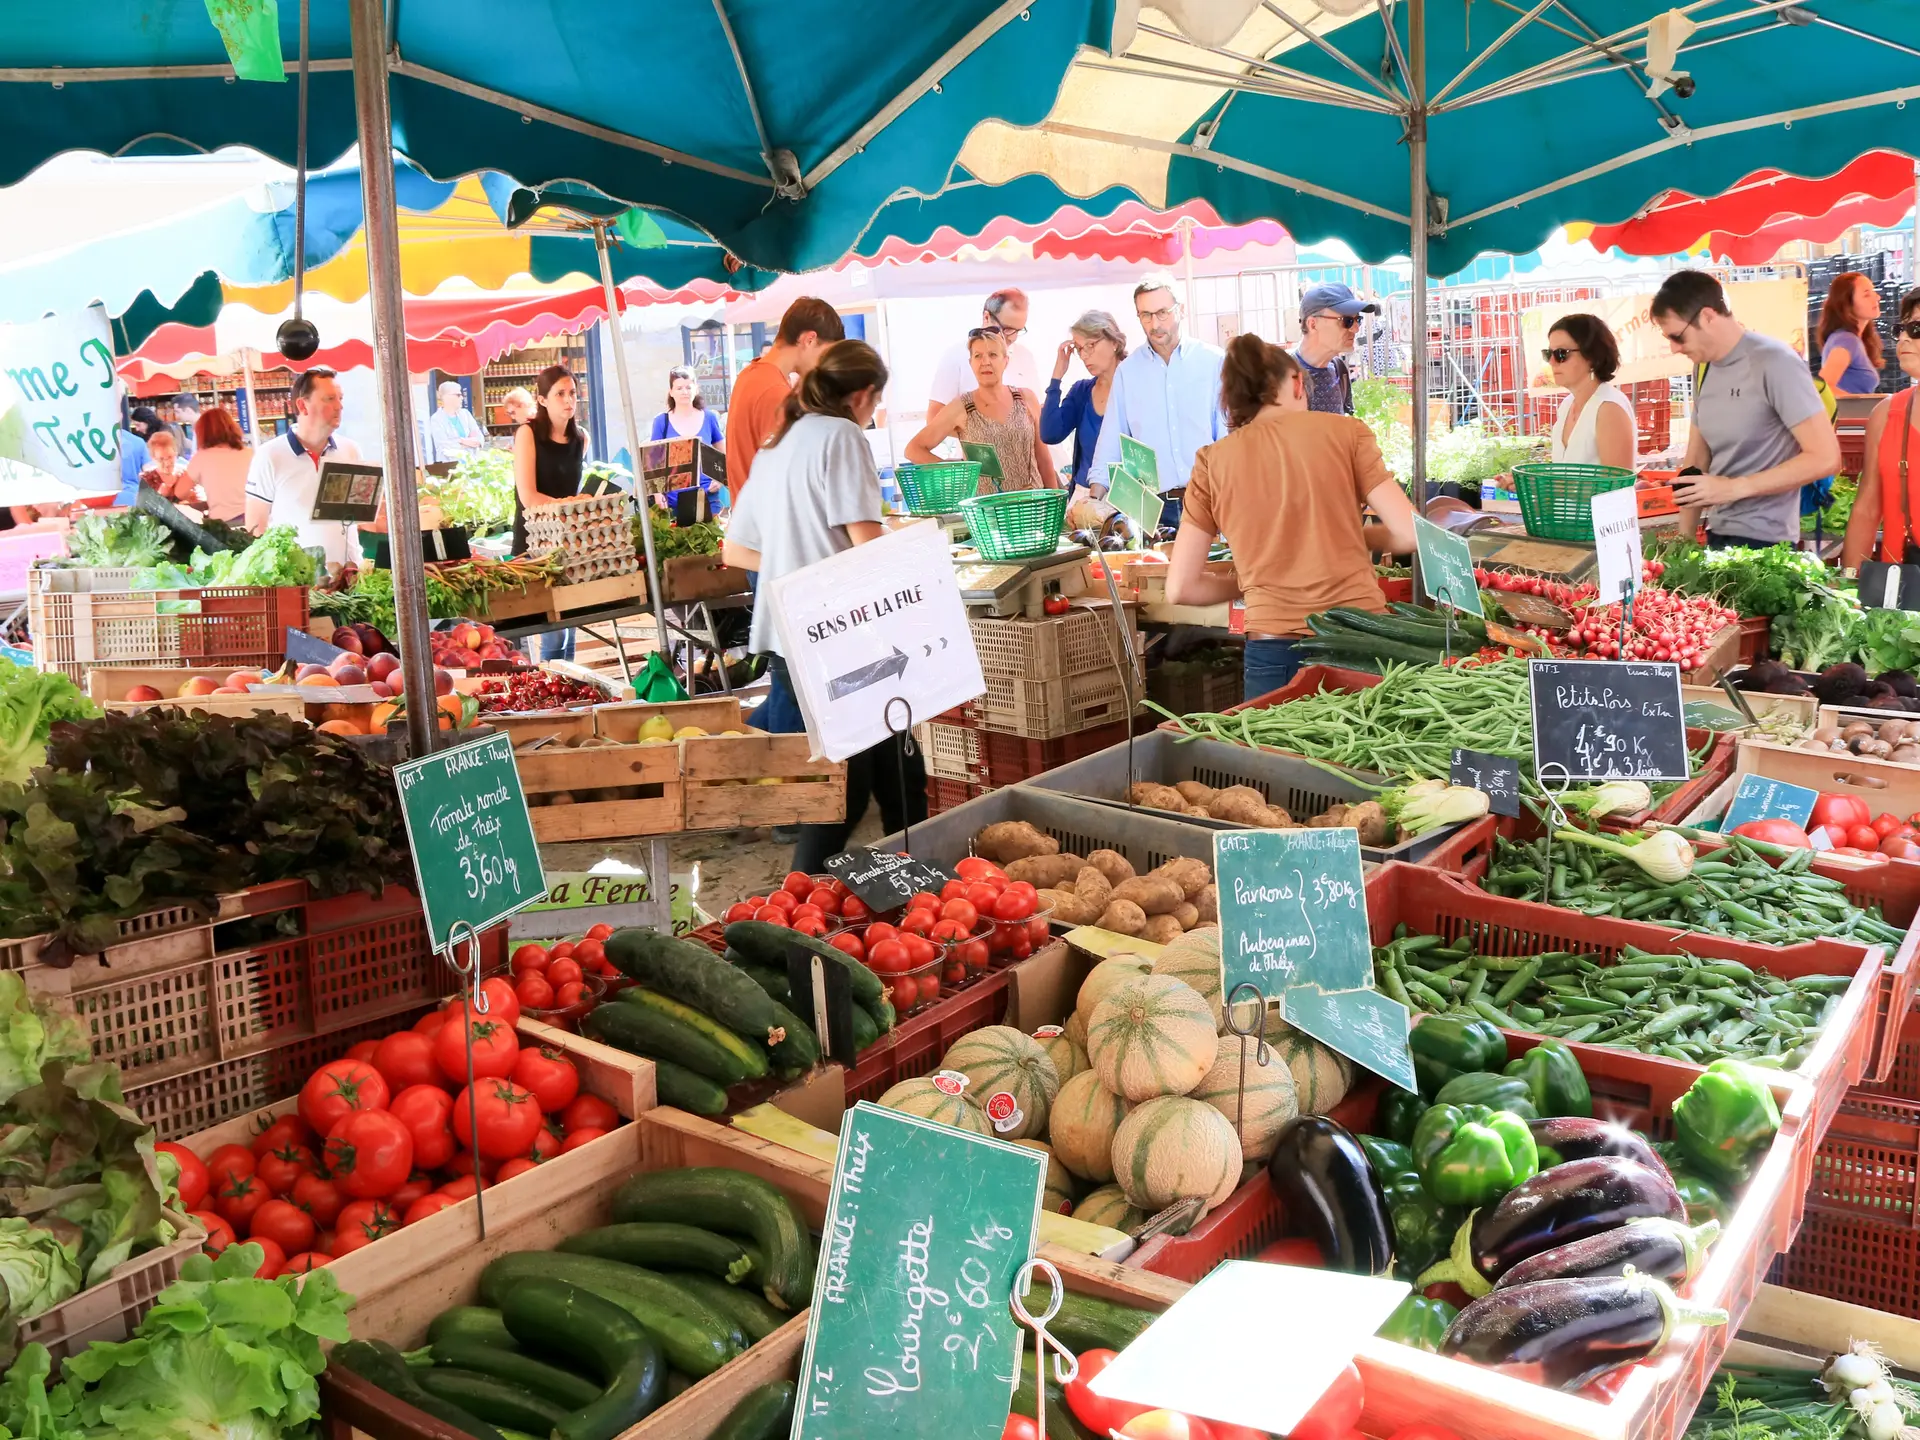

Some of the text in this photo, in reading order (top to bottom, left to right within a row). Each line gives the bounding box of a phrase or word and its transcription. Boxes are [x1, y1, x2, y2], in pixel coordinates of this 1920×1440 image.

[806, 583, 924, 644] SENS DE LA FILE
[1622, 756, 1634, 777] 3
[430, 776, 512, 836] Tomate ronde
[454, 826, 473, 852] de
[536, 882, 571, 904] a
[863, 1214, 950, 1397] Courgette
